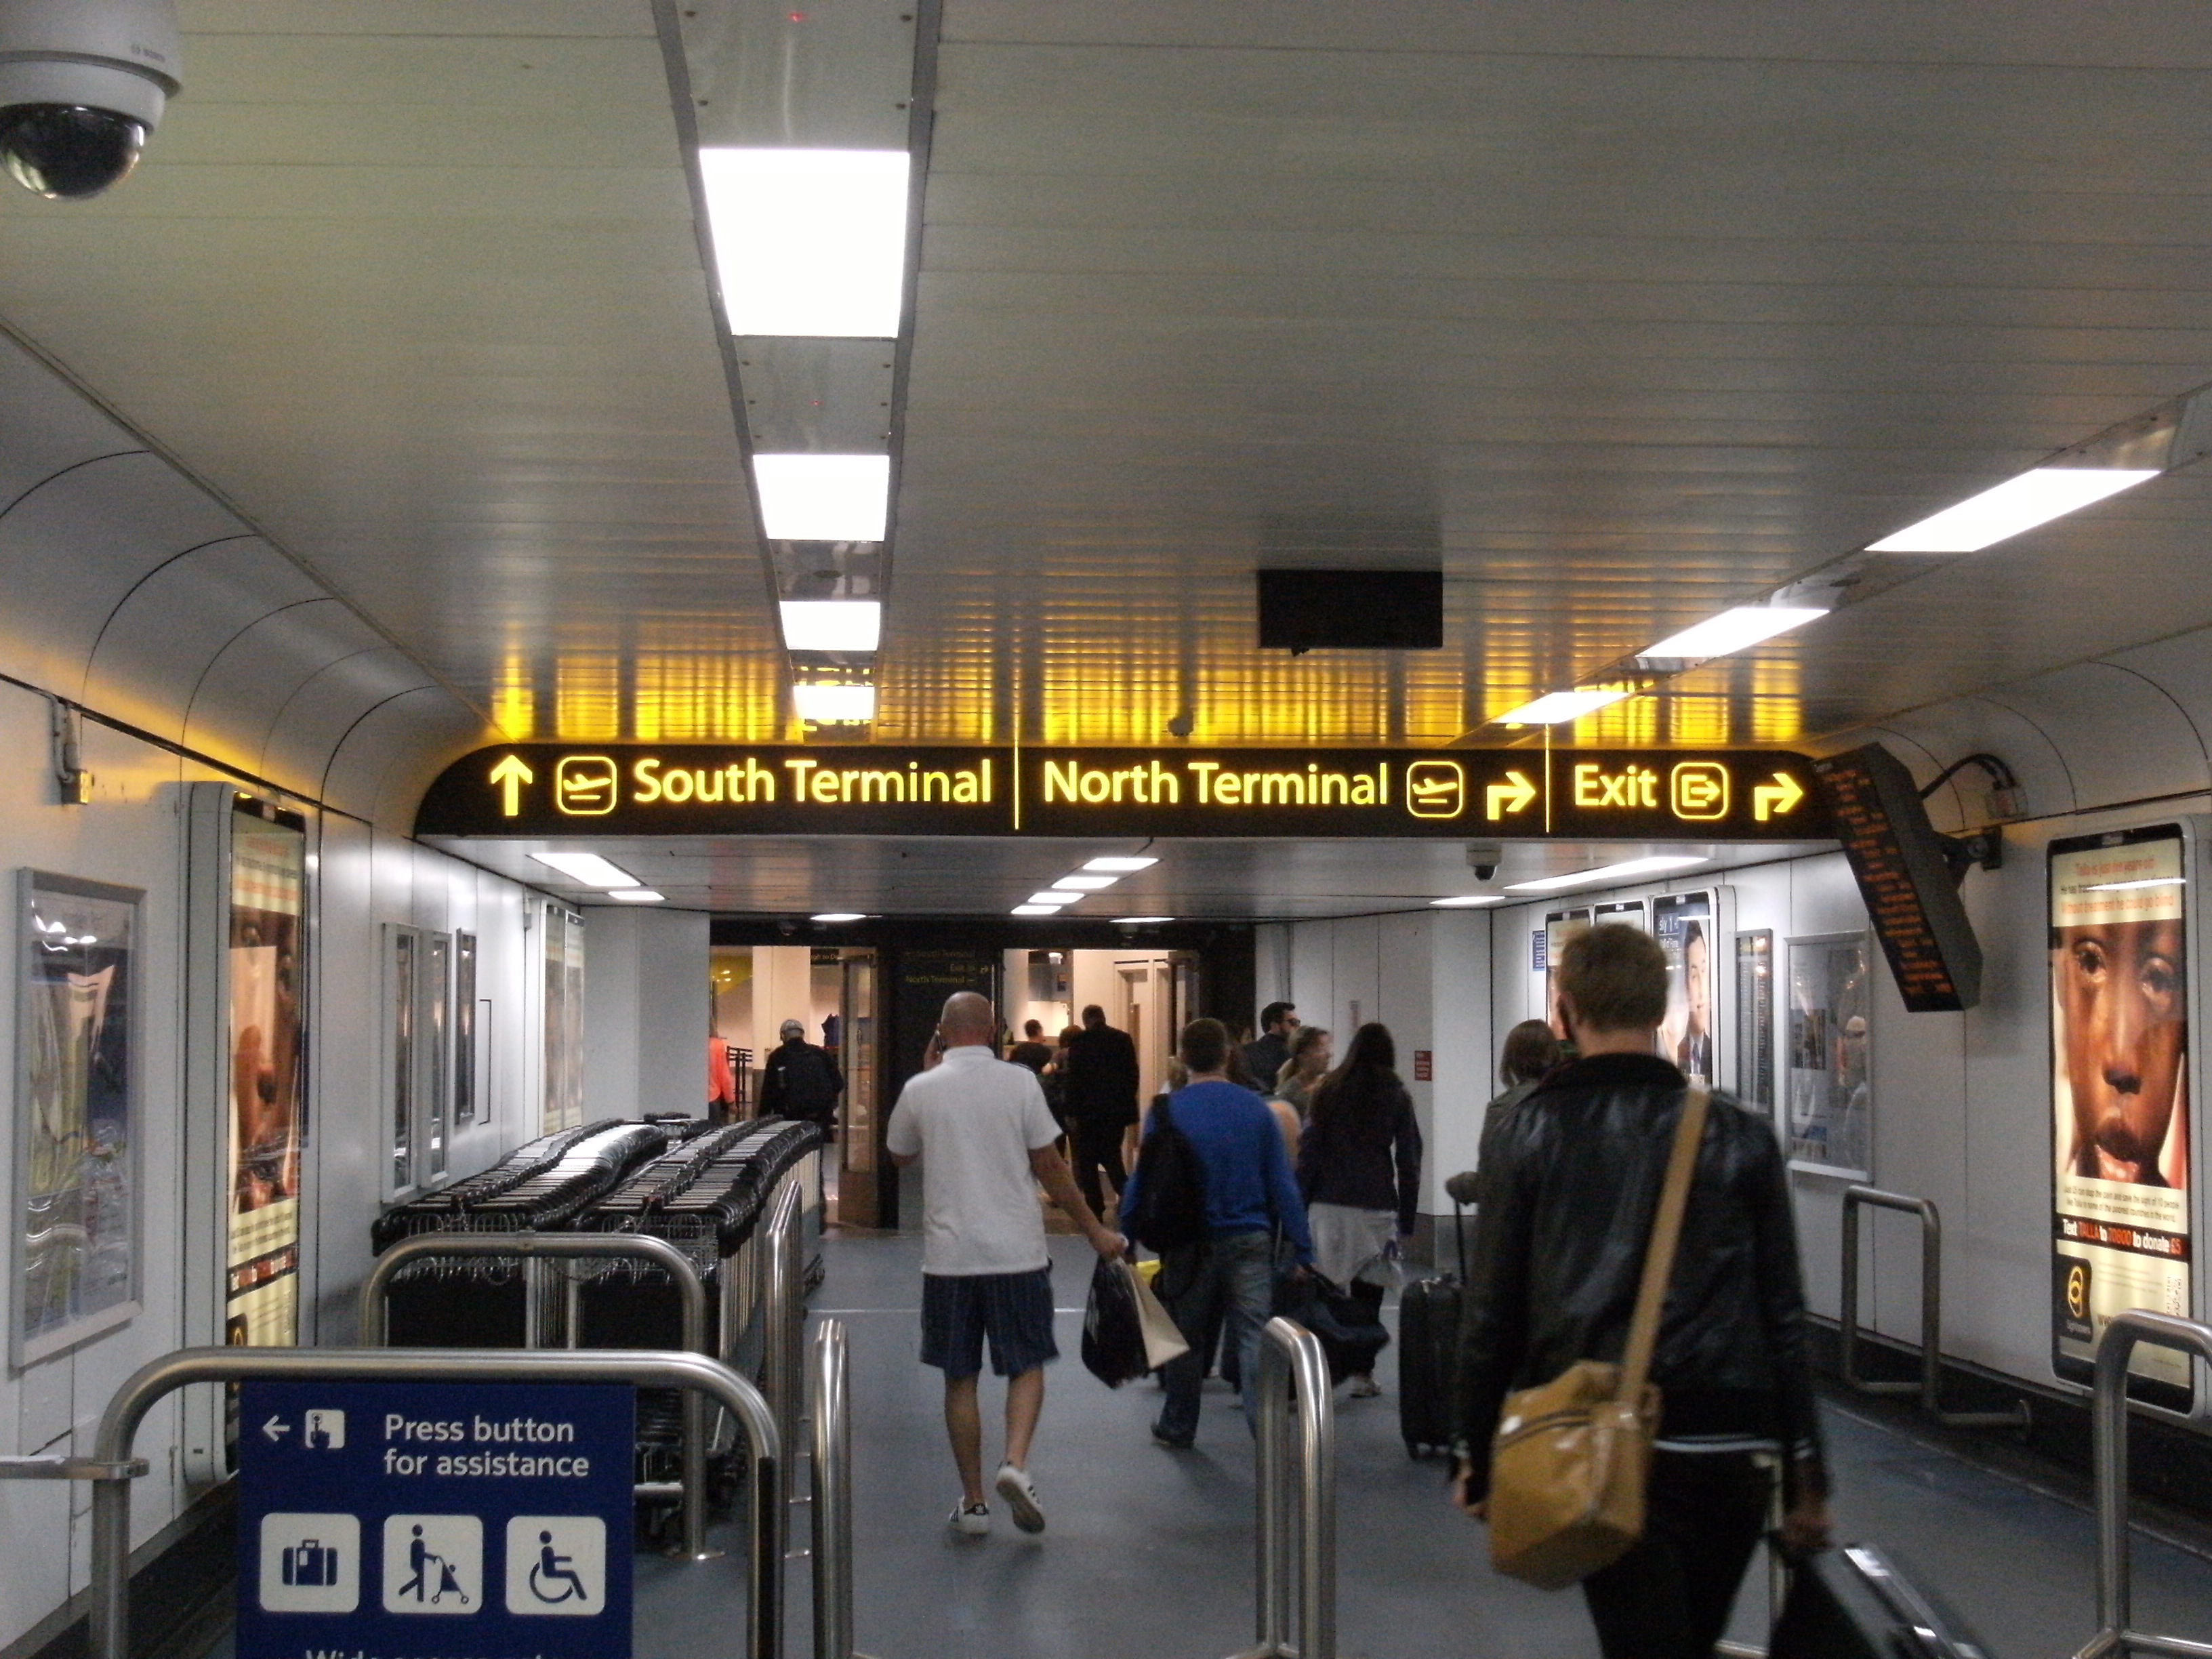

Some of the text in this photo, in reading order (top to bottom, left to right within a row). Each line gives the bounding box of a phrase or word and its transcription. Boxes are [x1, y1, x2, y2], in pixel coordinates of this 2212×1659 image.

[633, 757, 992, 803] South Terminal
[1044, 760, 1388, 805] North Terminal
[1574, 763, 1658, 807] Exit
[386, 1414, 574, 1442] Press button
[384, 1448, 590, 1477] for assistance
